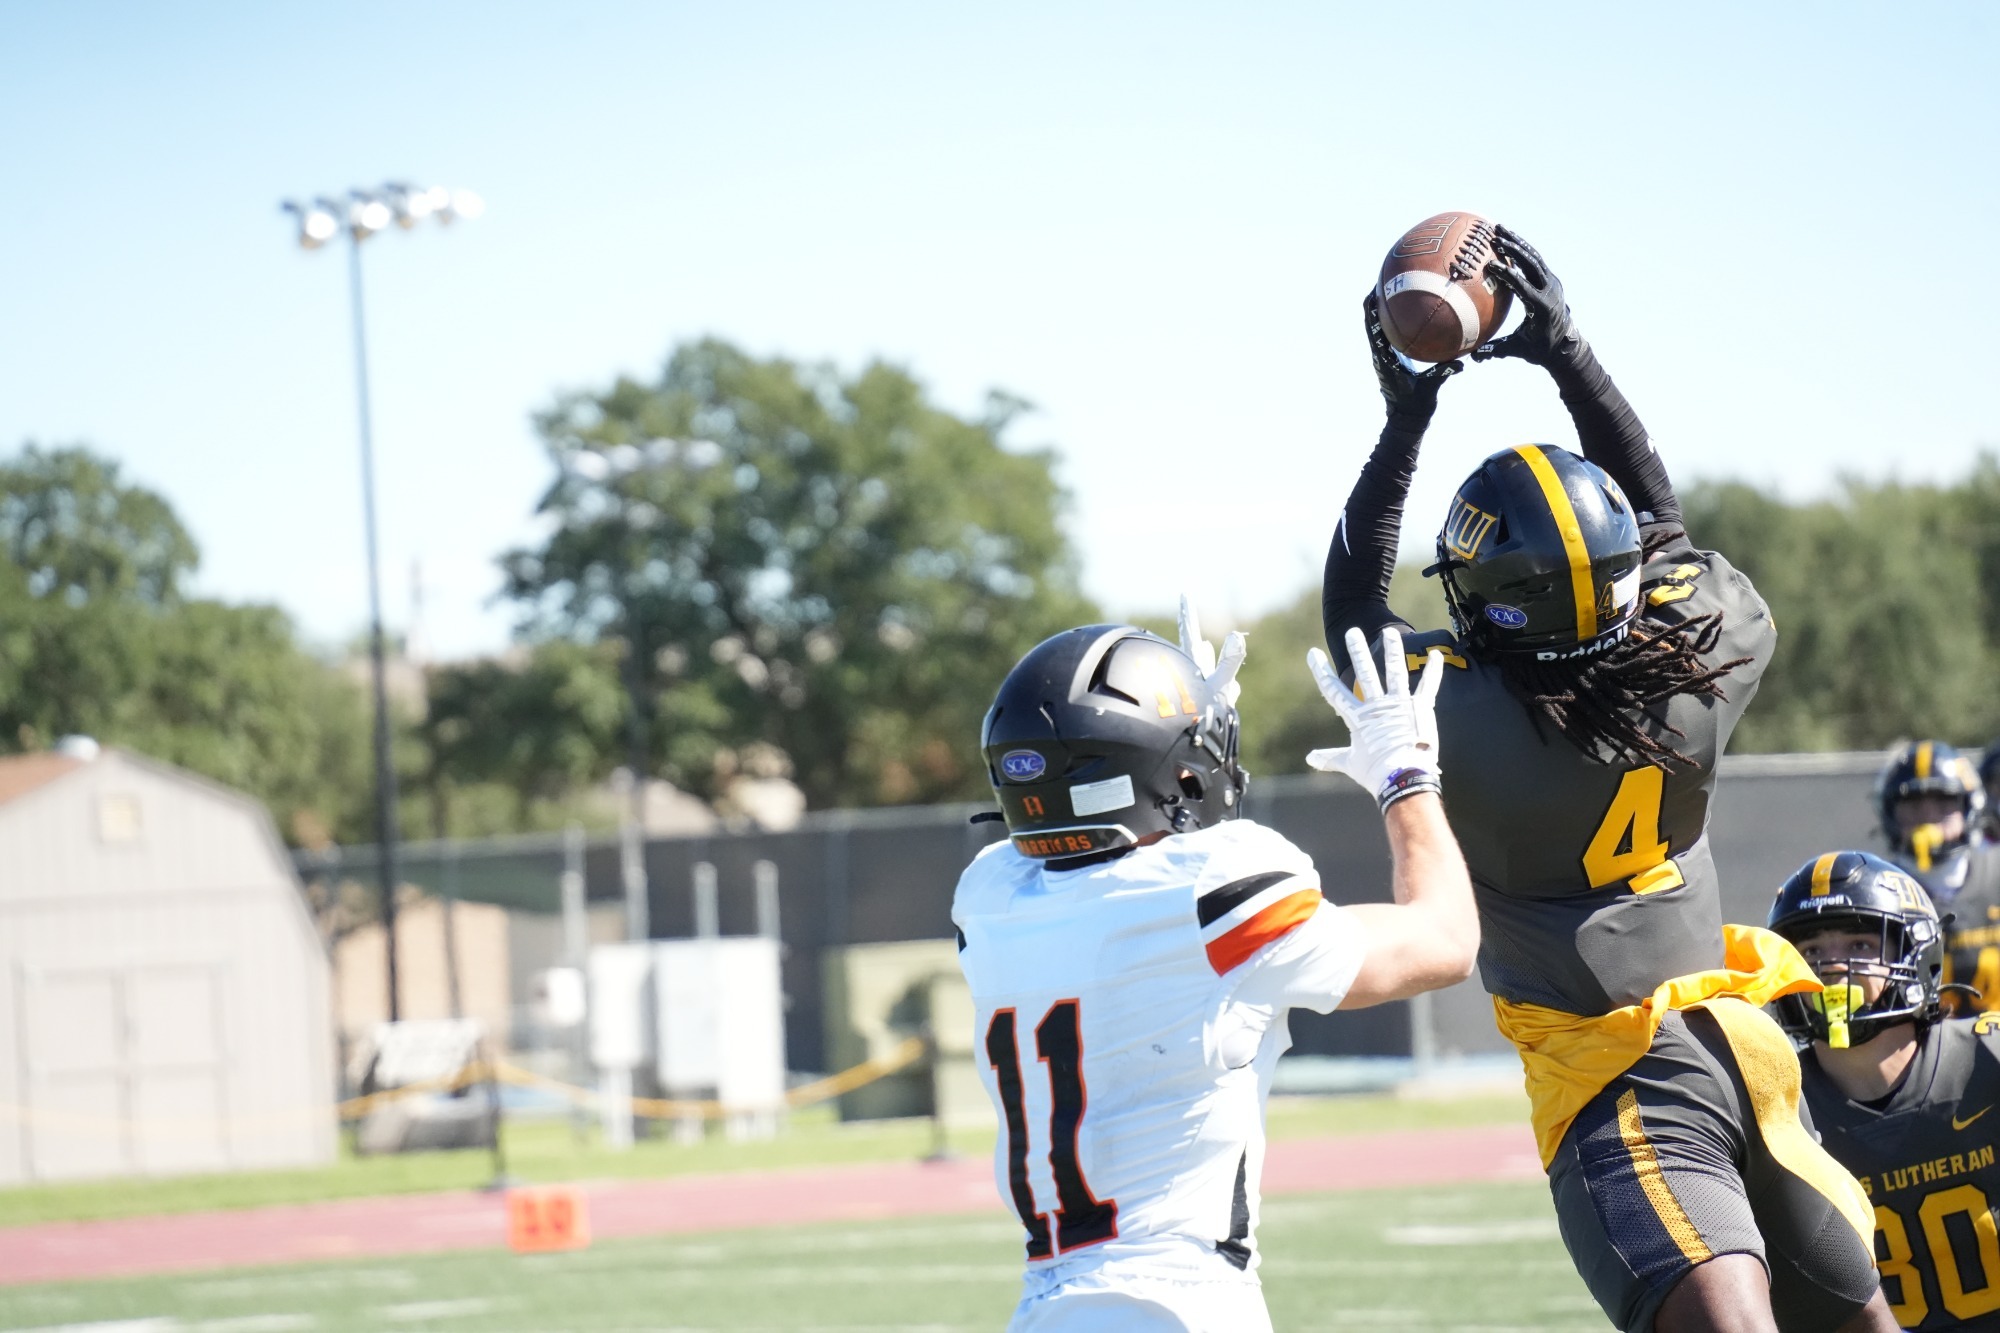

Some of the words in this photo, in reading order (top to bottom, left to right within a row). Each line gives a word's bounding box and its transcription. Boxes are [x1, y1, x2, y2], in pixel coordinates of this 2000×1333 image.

[1490, 608, 1520, 624] SCAC
[1596, 581, 1618, 620] 4
[1537, 623, 1629, 661] Rddell
[1006, 757, 1039, 774] SCAC
[1581, 764, 1686, 896] 4
[986, 998, 1118, 1260] 11
[1882, 1145, 1995, 1192] LUTHERAN
